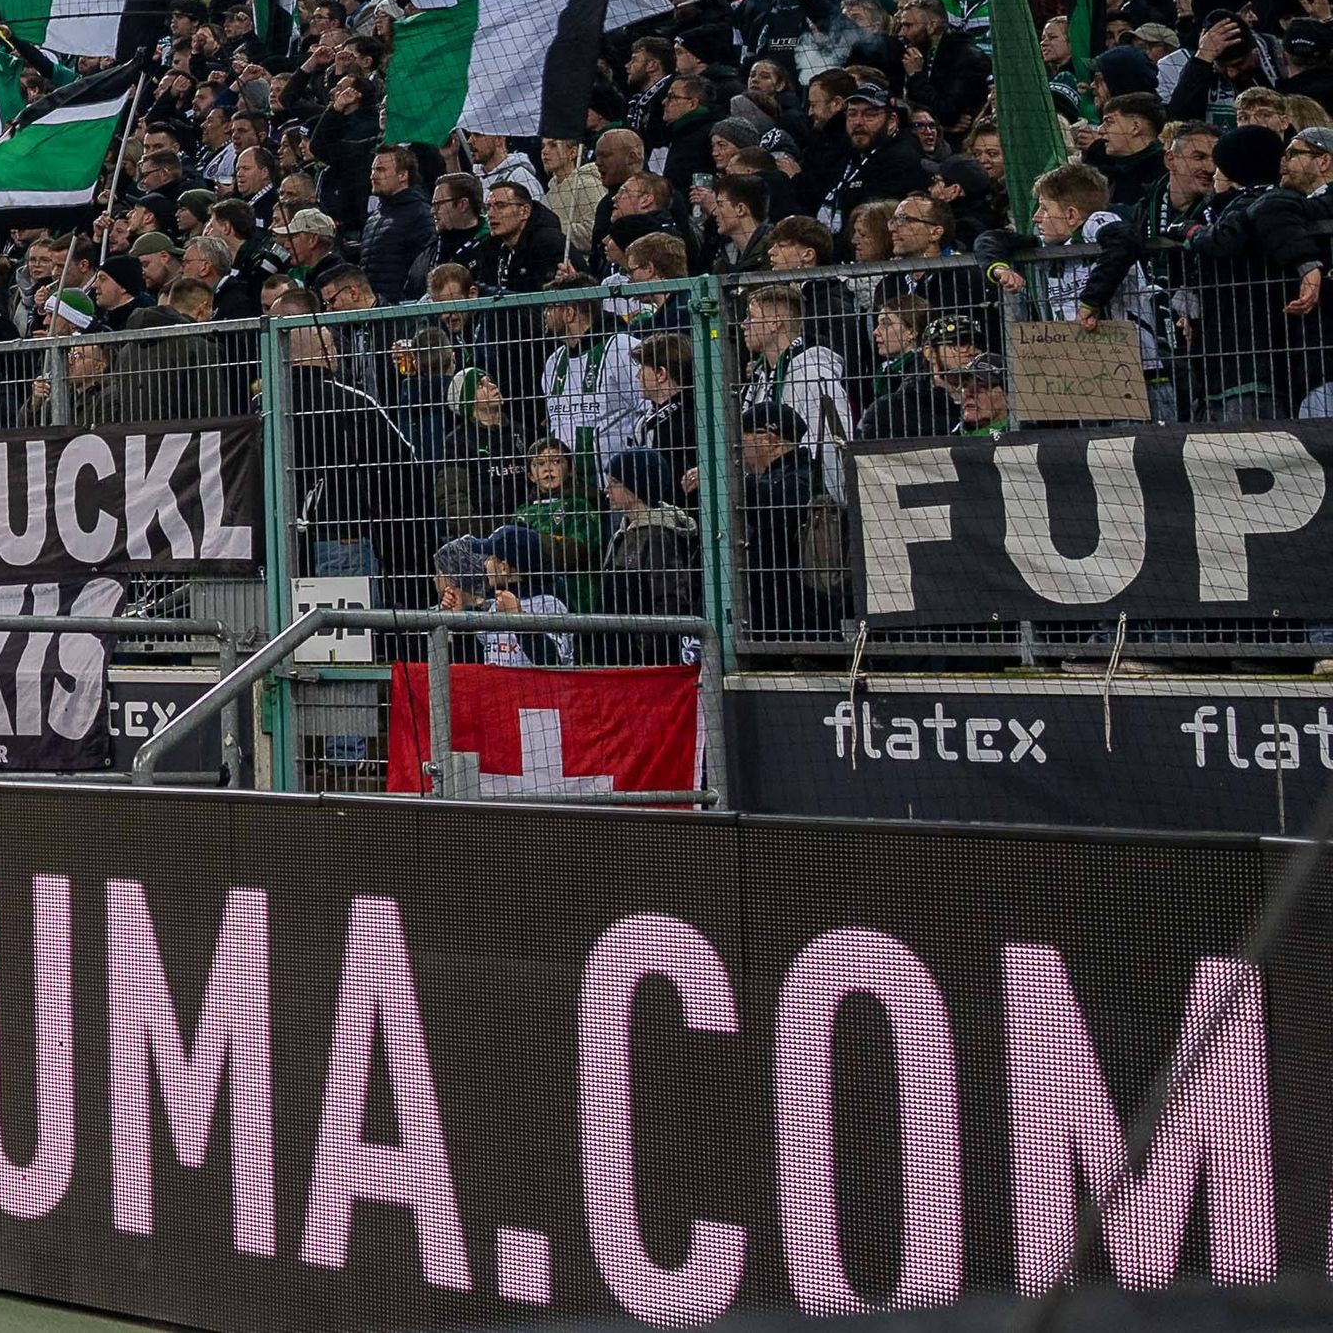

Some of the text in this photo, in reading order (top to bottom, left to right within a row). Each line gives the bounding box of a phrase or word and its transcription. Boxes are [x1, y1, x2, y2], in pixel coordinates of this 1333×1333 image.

[1020, 325, 1070, 345] Lieber
[854, 432, 1327, 615] FUP
[823, 700, 1047, 764] flatex
